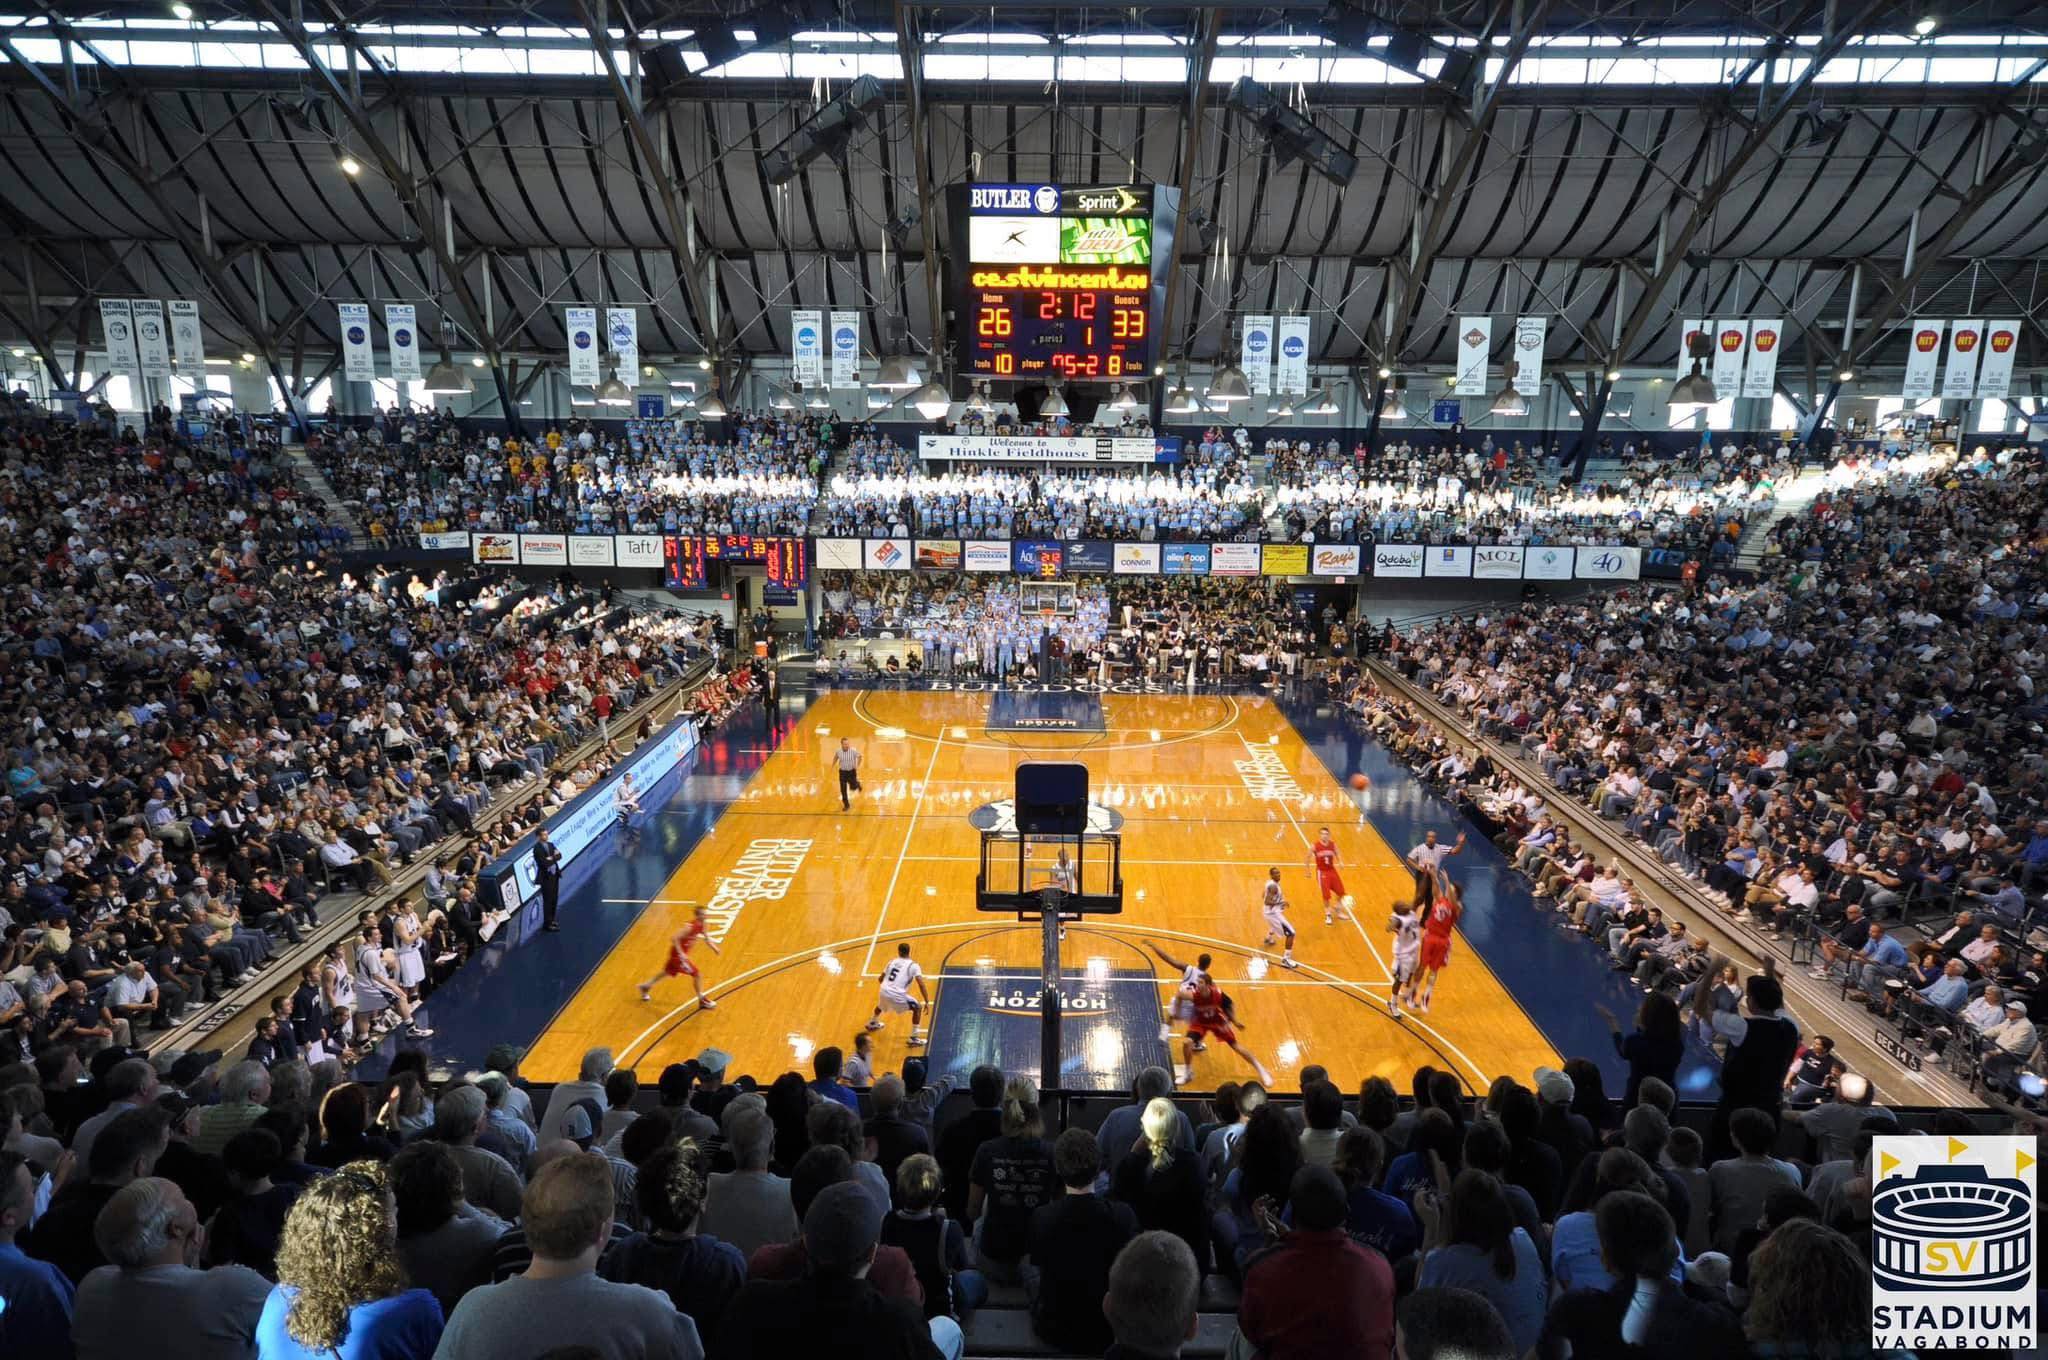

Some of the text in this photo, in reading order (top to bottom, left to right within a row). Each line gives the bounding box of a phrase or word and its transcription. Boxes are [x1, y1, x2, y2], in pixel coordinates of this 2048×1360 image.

[971, 188, 1031, 209] BUTLER
[1078, 194, 1118, 212] Sprint
[1039, 292, 1096, 320] 2:12
[979, 308, 1011, 335] 26
[1113, 310, 1144, 337] 33
[1087, 327, 1092, 345] 1
[1723, 336, 1739, 346] NIT
[1757, 335, 1773, 345] NIT
[1918, 336, 1934, 345] NIT
[1957, 336, 1973, 345] NIT
[1994, 337, 2010, 346] NIT
[996, 354, 1012, 373] 10
[1022, 360, 1046, 369] player
[1108, 355, 1120, 375] 8
[990, 437, 1047, 447] Welcome to
[950, 448, 1089, 458] Hinkle Fieldhouse
[424, 536, 439, 546] 40
[753, 542, 766, 554] 33
[1377, 552, 1411, 565] Qdoba
[1477, 551, 1520, 563] MCL
[1592, 552, 1622, 573] 40
[1041, 563, 1056, 576] 32
[929, 681, 1165, 693] BULLDOGS
[747, 839, 814, 901] BUTLER
[705, 838, 784, 944] UNIVERSITY
[888, 967, 900, 982] 5
[1896, 1047, 1907, 1062] 14
